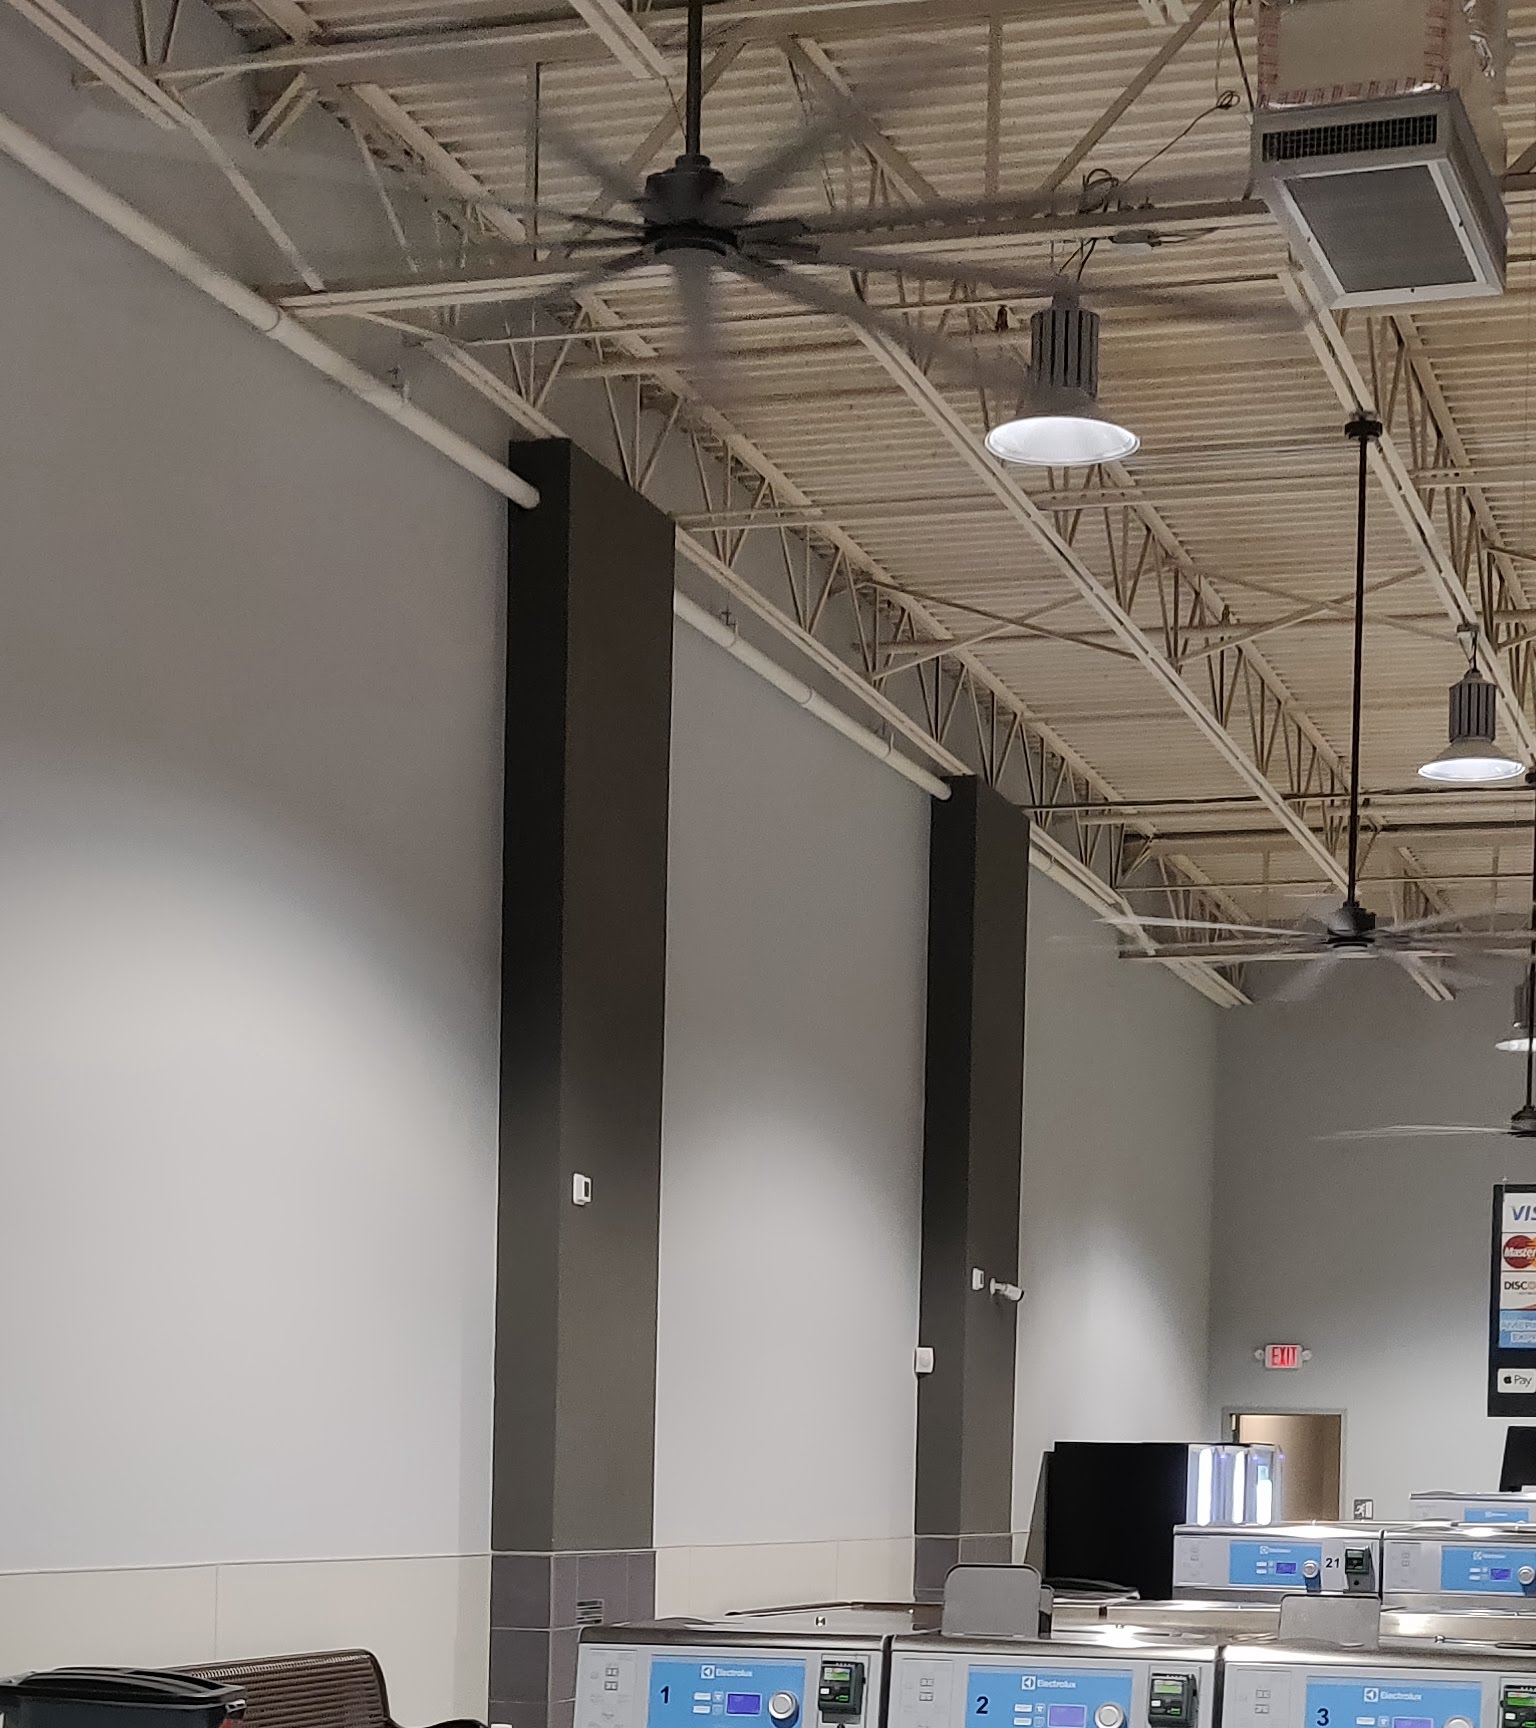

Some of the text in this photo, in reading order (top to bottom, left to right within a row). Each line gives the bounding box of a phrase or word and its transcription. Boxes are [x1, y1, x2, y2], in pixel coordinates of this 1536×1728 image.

[1271, 1347, 1297, 1366] EXIT
[1514, 1374, 1532, 1388] Pay
[1325, 1557, 1340, 1568] 21
[715, 1668, 753, 1679] Electrolux
[1037, 1679, 1076, 1690] Electrolux
[660, 1686, 670, 1703] 1
[1380, 1691, 1422, 1701] Electrolux
[975, 1696, 989, 1714] 2
[1316, 1708, 1330, 1726] 3
